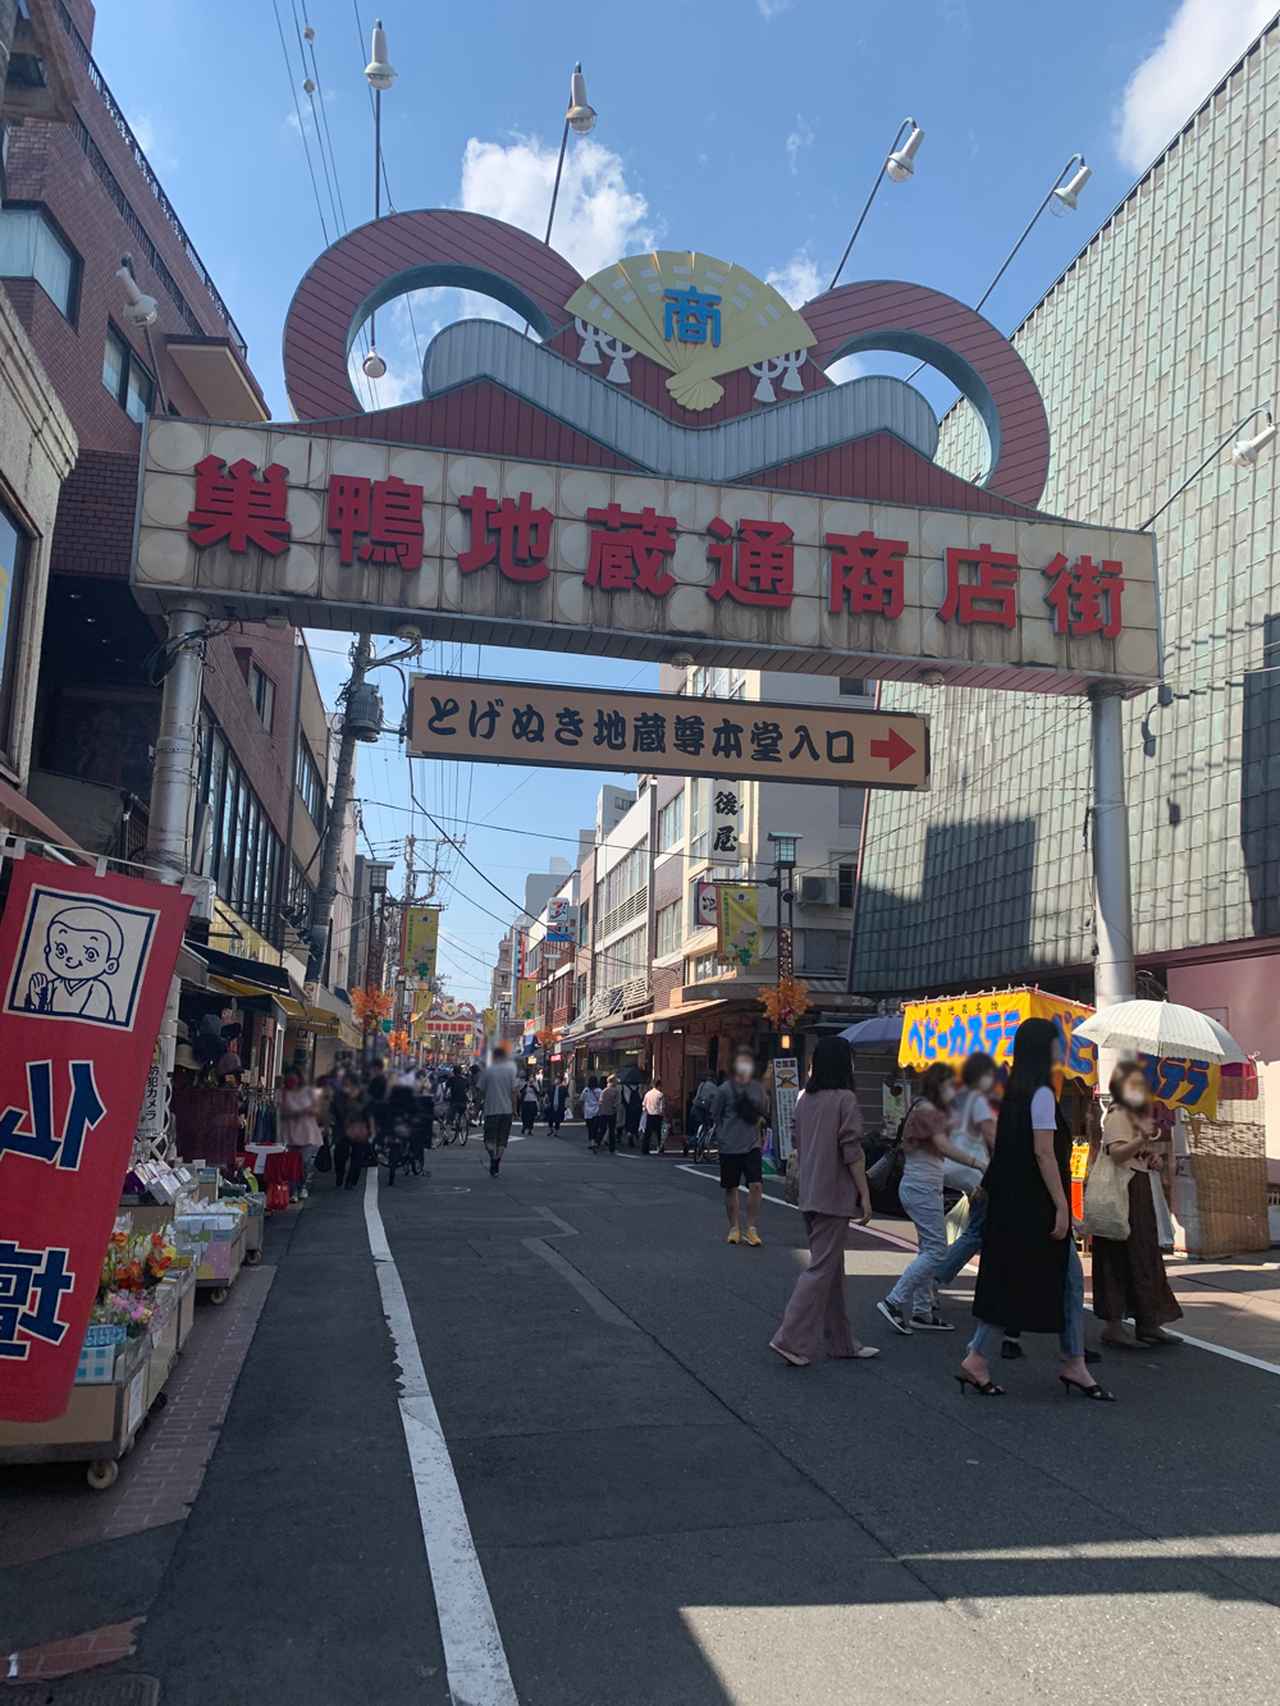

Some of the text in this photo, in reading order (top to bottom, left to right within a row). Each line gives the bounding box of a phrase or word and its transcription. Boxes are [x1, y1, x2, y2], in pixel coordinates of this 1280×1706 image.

[662, 284, 723, 348] 商
[188, 454, 1126, 640] 巣鴨地蔵通商店街
[425, 695, 856, 765] とげぬき地蔵尊本堂入口
[713, 779, 739, 852] 後屋
